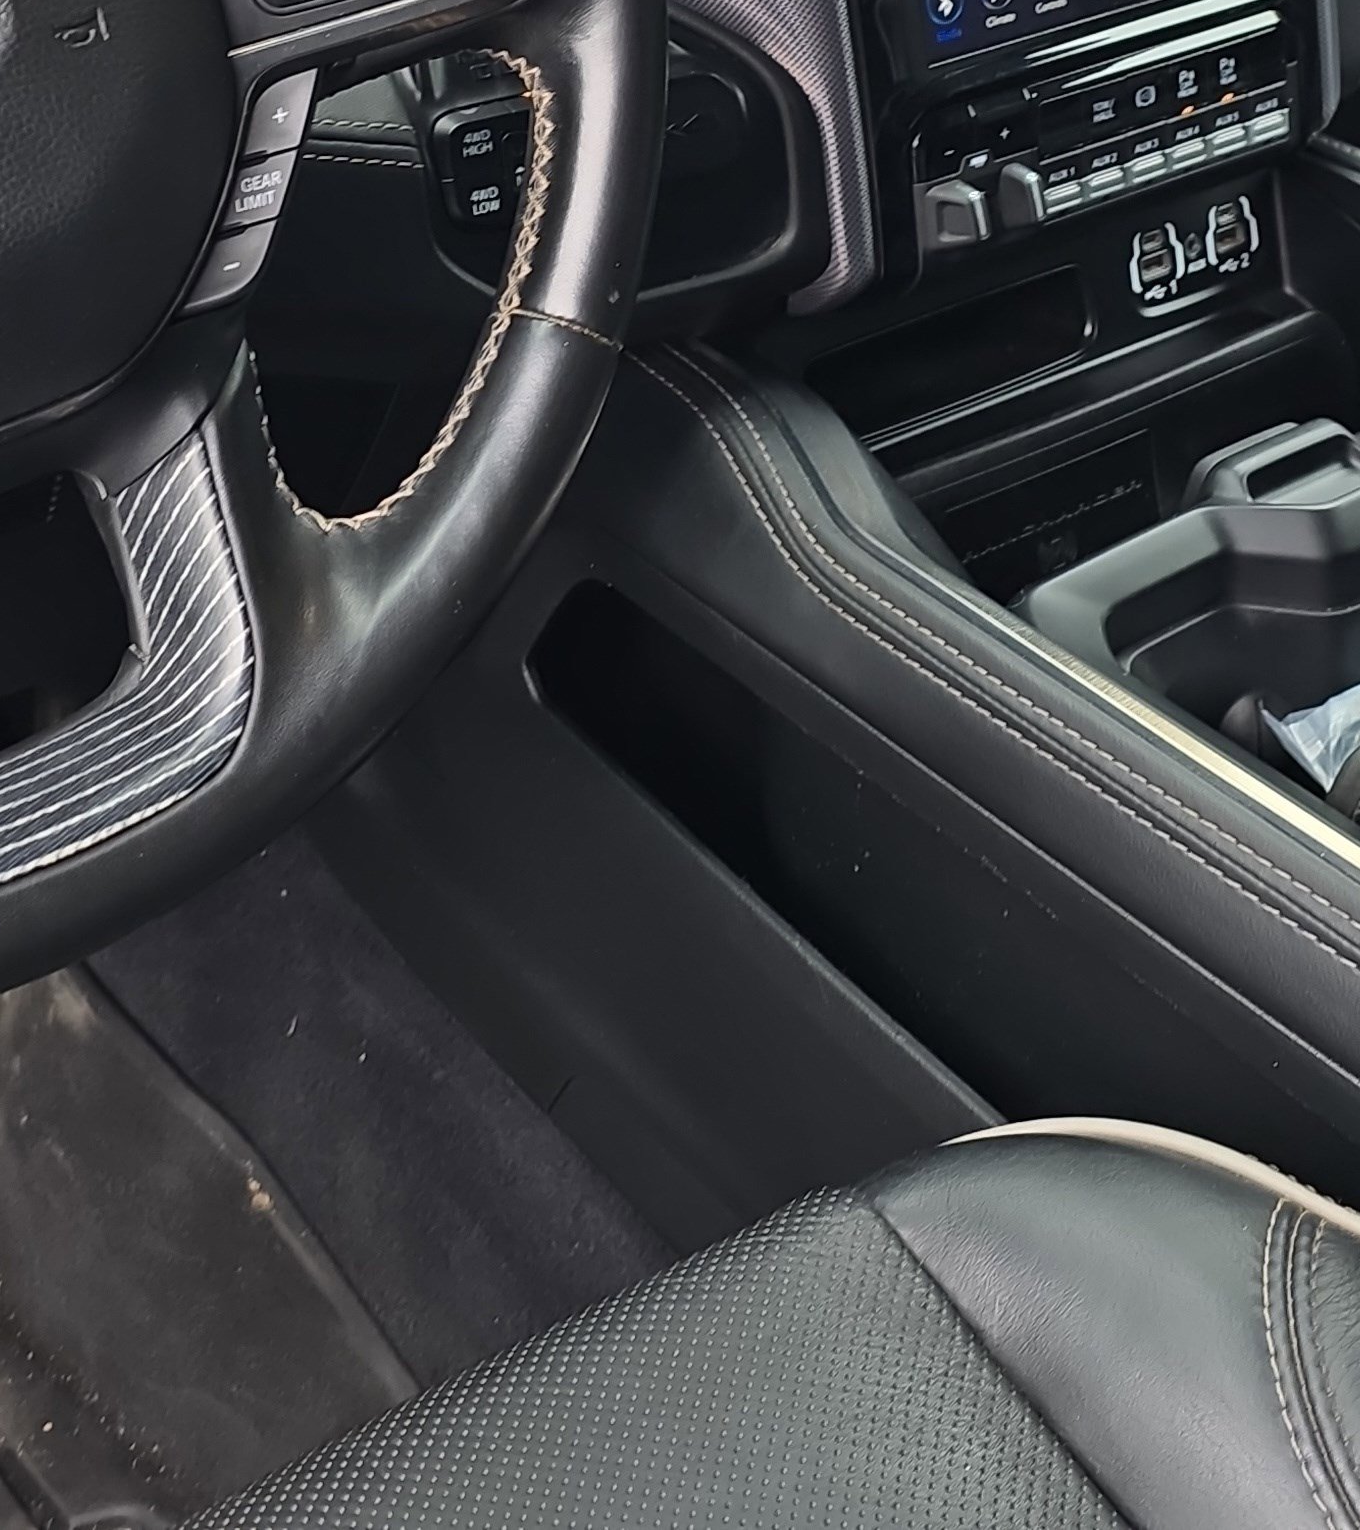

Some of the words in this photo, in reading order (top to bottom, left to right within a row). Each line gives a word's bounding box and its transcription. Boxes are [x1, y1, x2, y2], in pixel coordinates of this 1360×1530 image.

[463, 129, 491, 144] 4WD
[462, 141, 494, 158] HIGH
[240, 170, 283, 193] GEAR
[234, 190, 277, 213] LIMIT
[470, 186, 500, 202] 4WD
[472, 199, 501, 216] LOW
[1240, 252, 1251, 268] 2
[1169, 279, 1178, 294] 1
